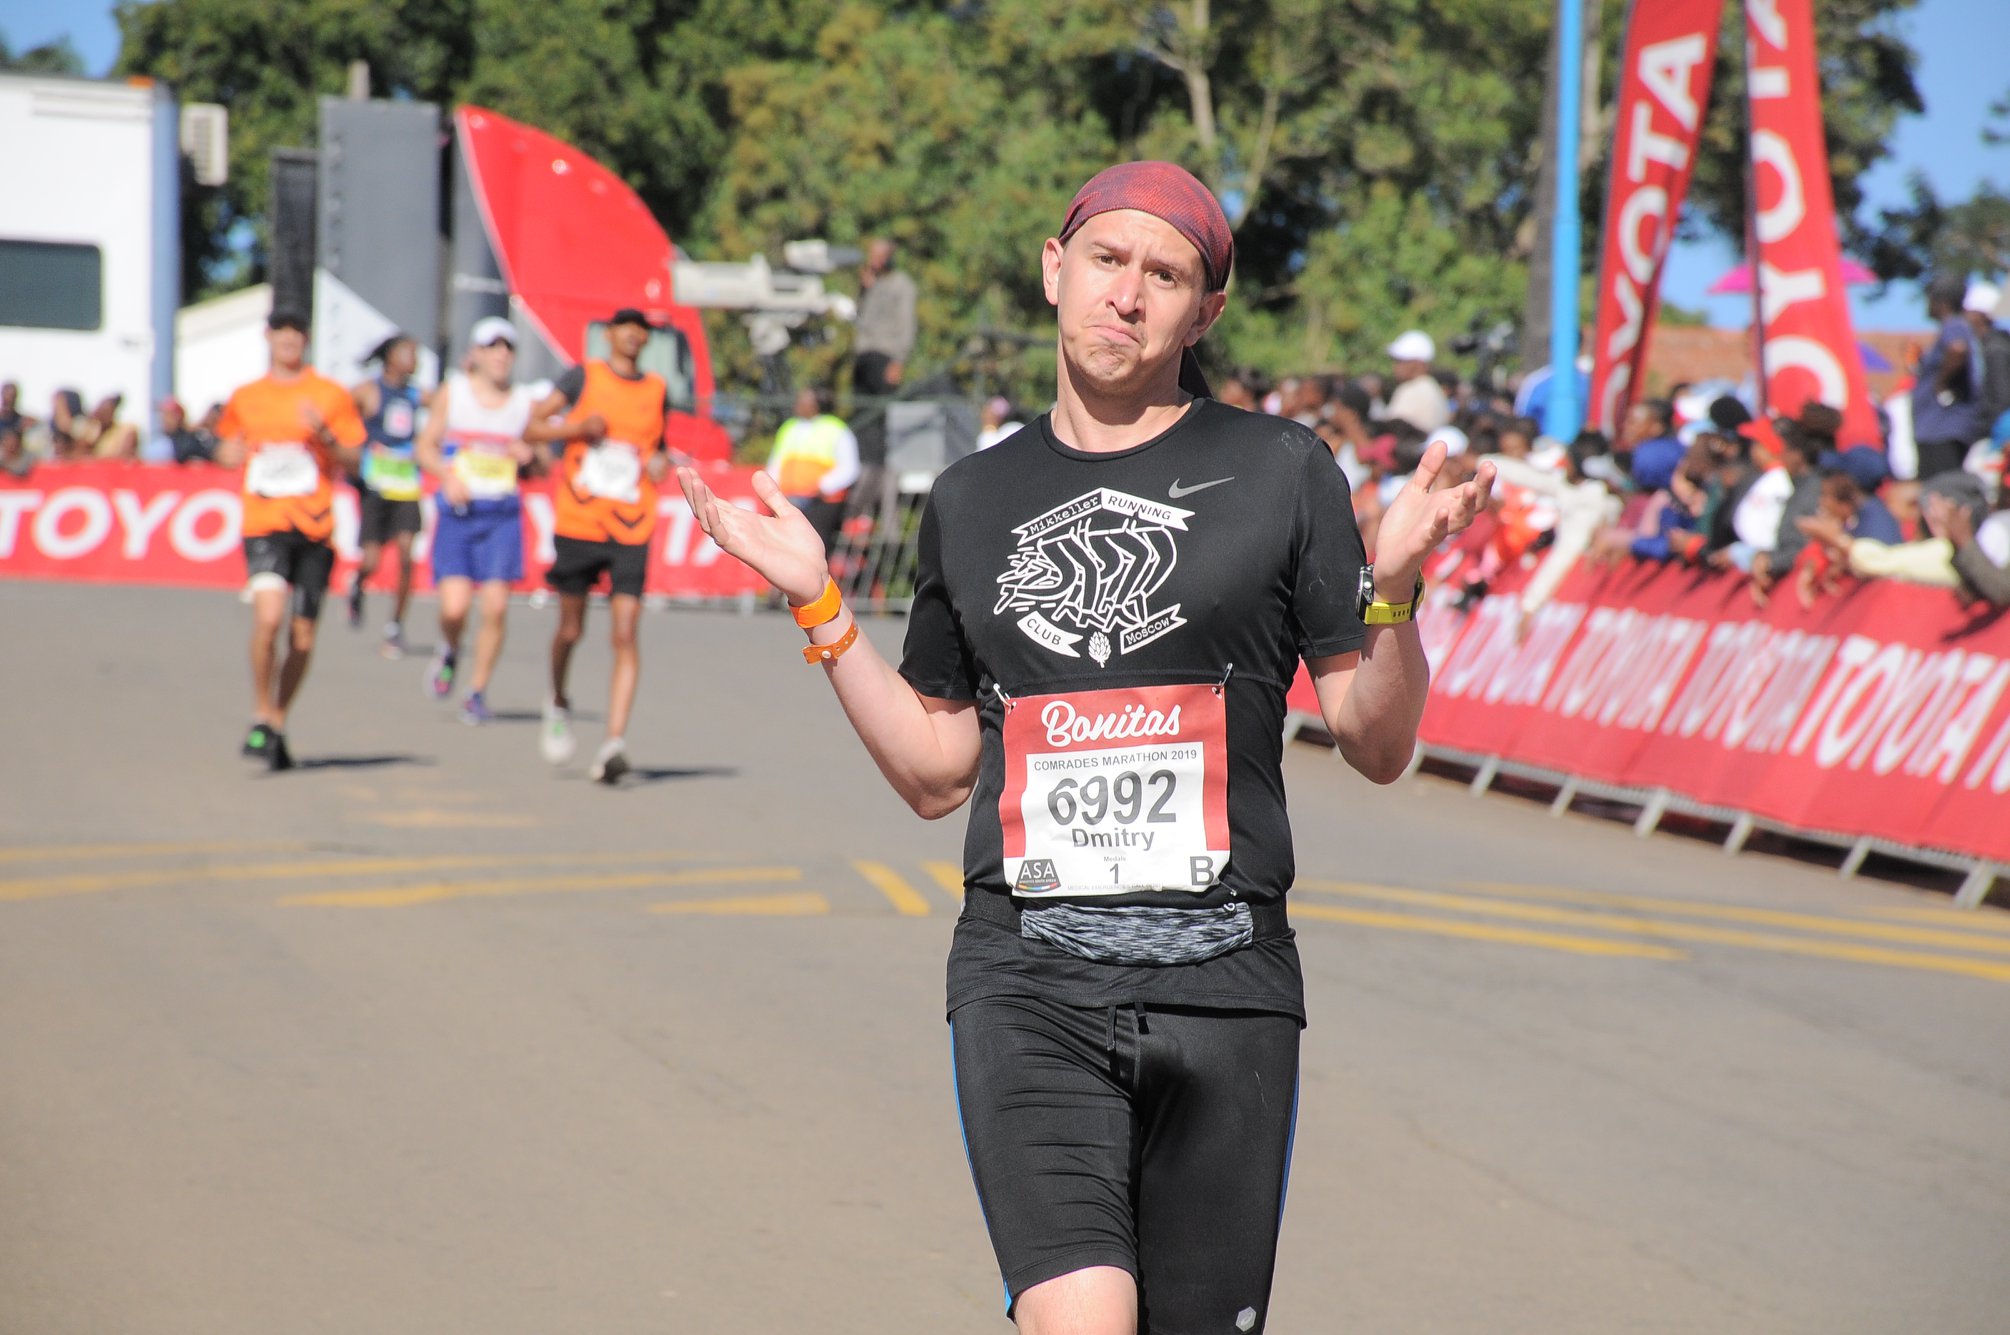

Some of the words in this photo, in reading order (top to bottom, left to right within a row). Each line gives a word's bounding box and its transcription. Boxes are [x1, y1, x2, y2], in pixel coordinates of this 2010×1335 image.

[1600, 31, 1708, 440] OYOTA
[1029, 495, 1100, 536] Mikkeller
[1108, 495, 1172, 521] RUNNING
[1025, 617, 1062, 646] CLUB
[1124, 615, 1171, 646] Moscow
[1426, 592, 1590, 706] TOTA
[1788, 632, 2003, 788] TOYOTA
[1041, 701, 1181, 747] Bonitas
[1034, 758, 1098, 771] COMRADES
[1102, 751, 1168, 767] MARATHON
[1171, 749, 1198, 761] 2019
[1048, 770, 1177, 825] 6992
[1072, 828, 1155, 851] Dmitry
[1021, 862, 1055, 879] ASA
[1108, 863, 1120, 885] 1
[1189, 855, 1215, 887] B
